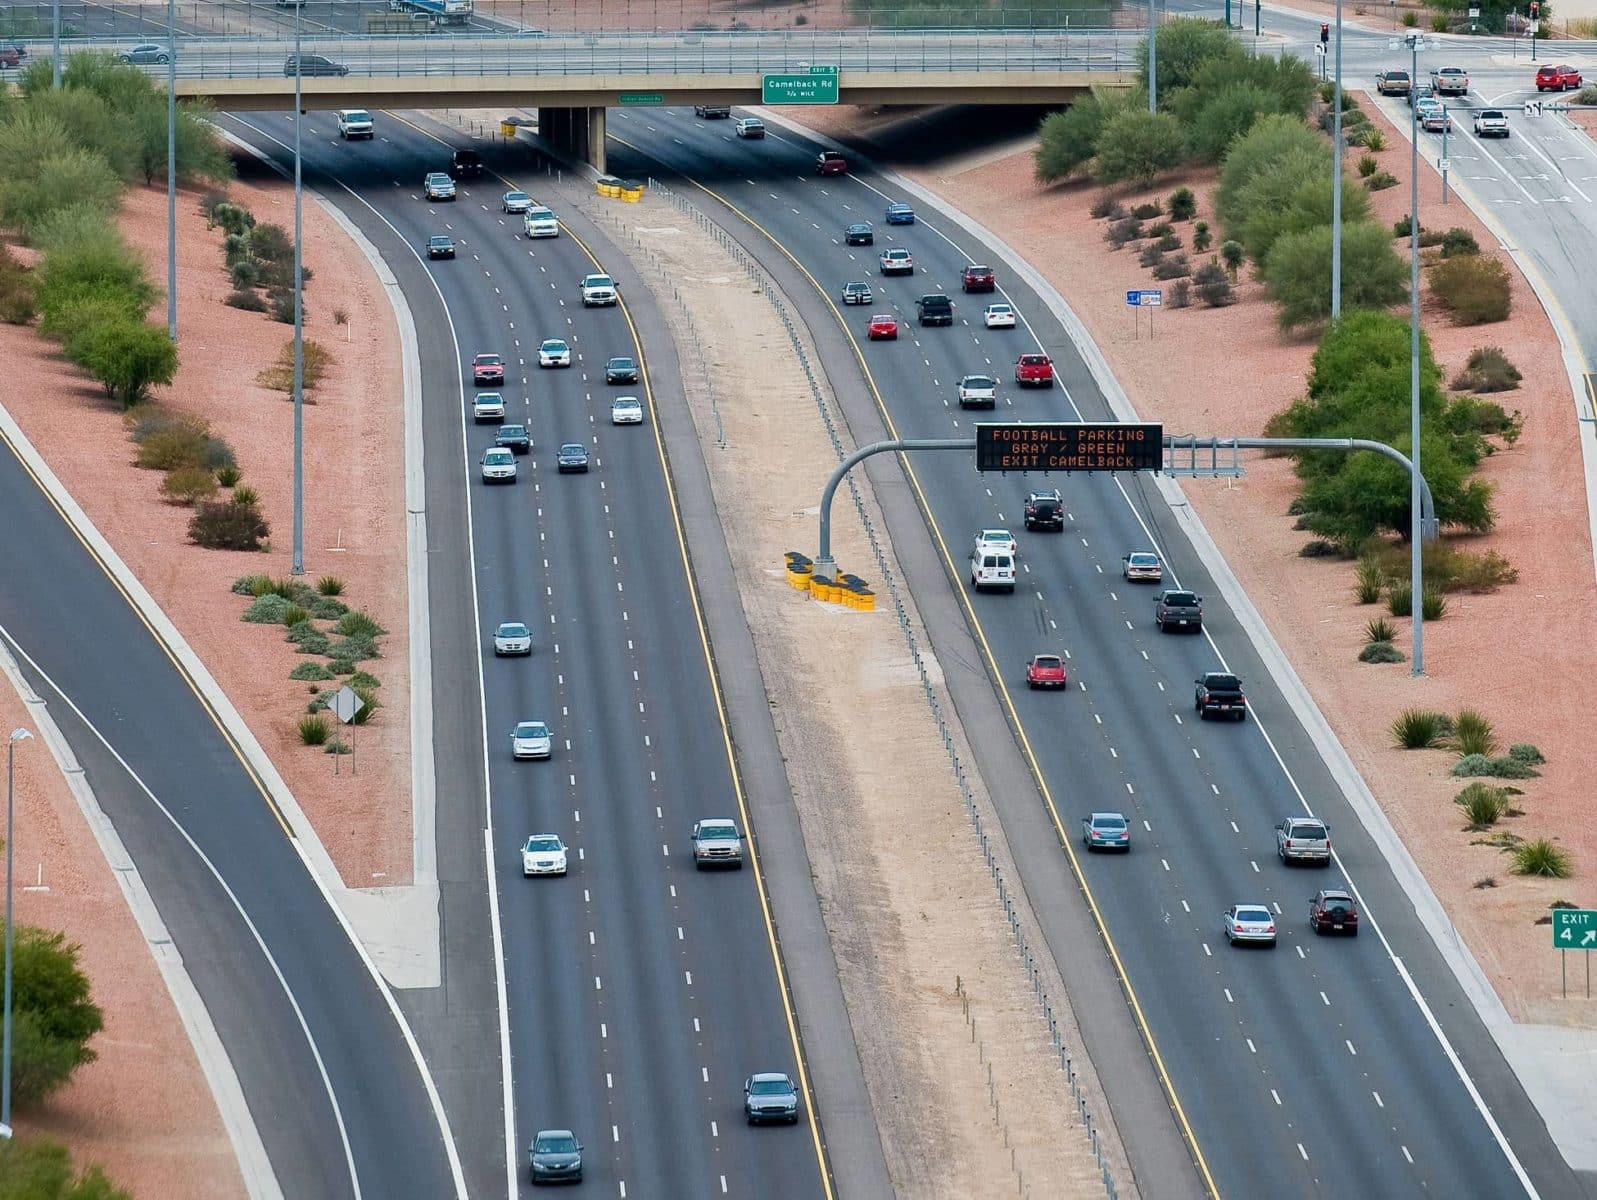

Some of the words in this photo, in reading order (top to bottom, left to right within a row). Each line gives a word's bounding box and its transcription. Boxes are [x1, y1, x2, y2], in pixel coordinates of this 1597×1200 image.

[768, 80, 817, 88] Camelback
[821, 80, 833, 88] Rd
[992, 430, 1067, 441] FOOTBALL
[1078, 430, 1145, 441] PARKING
[1012, 443, 1048, 454] GRAY
[1059, 444, 1067, 453] /
[1078, 443, 1125, 454] GREEN
[1002, 456, 1038, 467] EXIT
[1049, 456, 1135, 467] CAMELBACK
[1562, 914, 1589, 924] EXIT
[1560, 927, 1572, 941] 4
